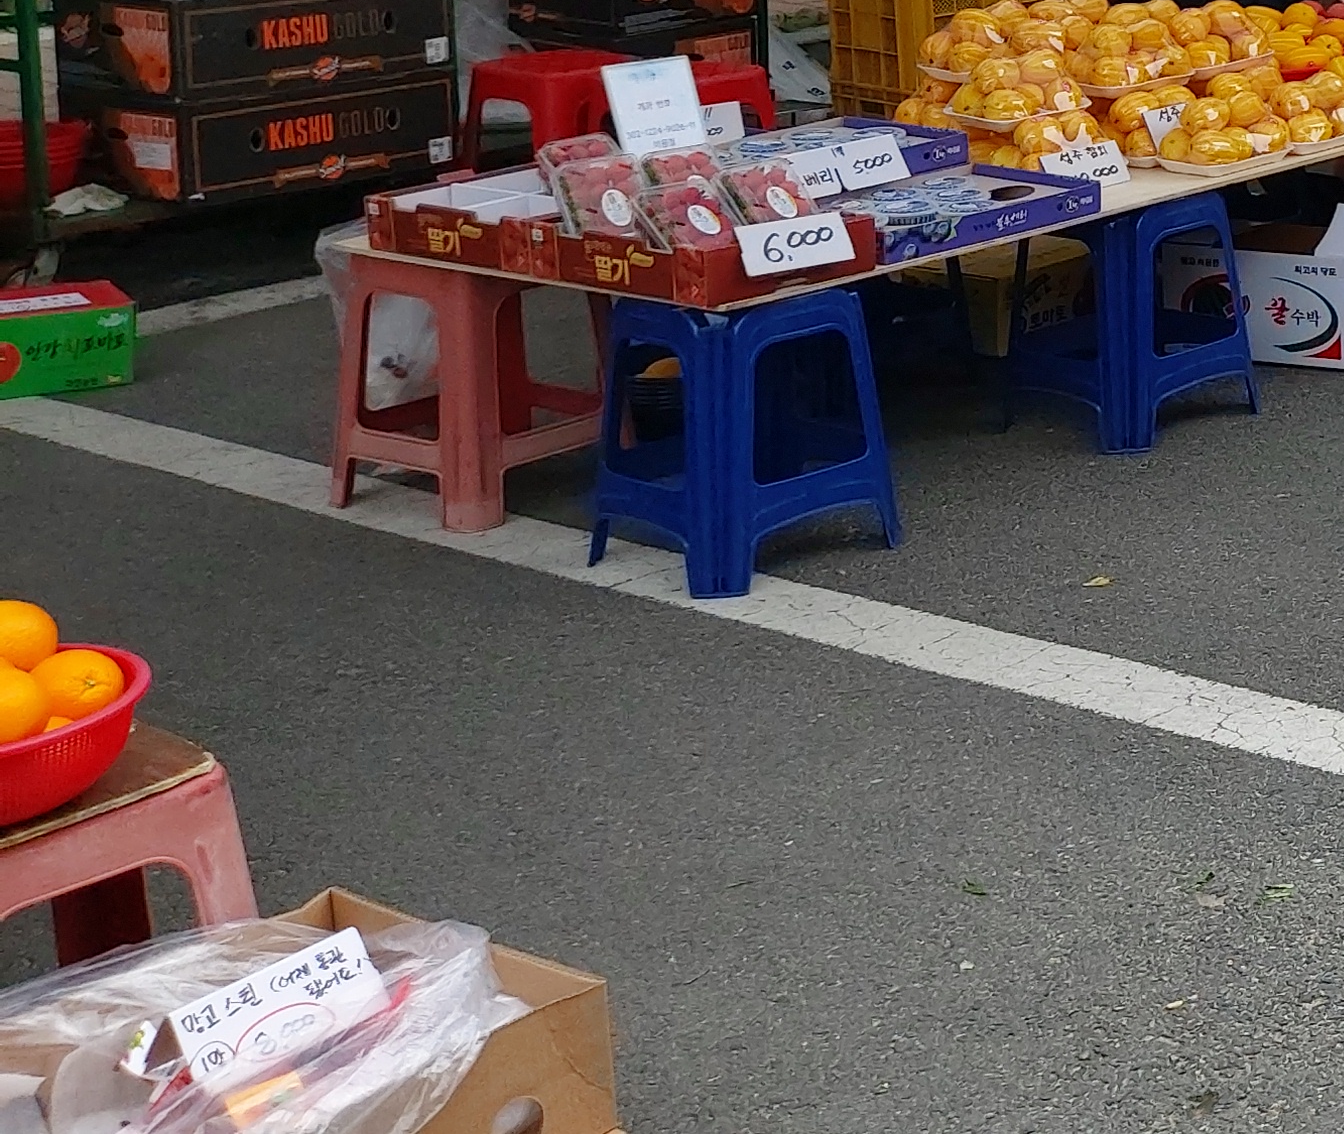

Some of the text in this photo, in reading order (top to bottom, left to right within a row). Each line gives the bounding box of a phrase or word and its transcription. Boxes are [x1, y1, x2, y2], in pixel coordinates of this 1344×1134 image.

[261, 13, 329, 50] KASHU
[267, 113, 335, 151] KASHU
[1060, 149, 1083, 165] 성주
[801, 167, 833, 188] 베리
[427, 227, 462, 257] 딸기
[763, 225, 834, 263] 6,000
[594, 255, 630, 286] 딸기
[1290, 309, 1321, 328] 수박
[181, 1003, 222, 1034] 망고
[224, 982, 264, 1017] 스틴
